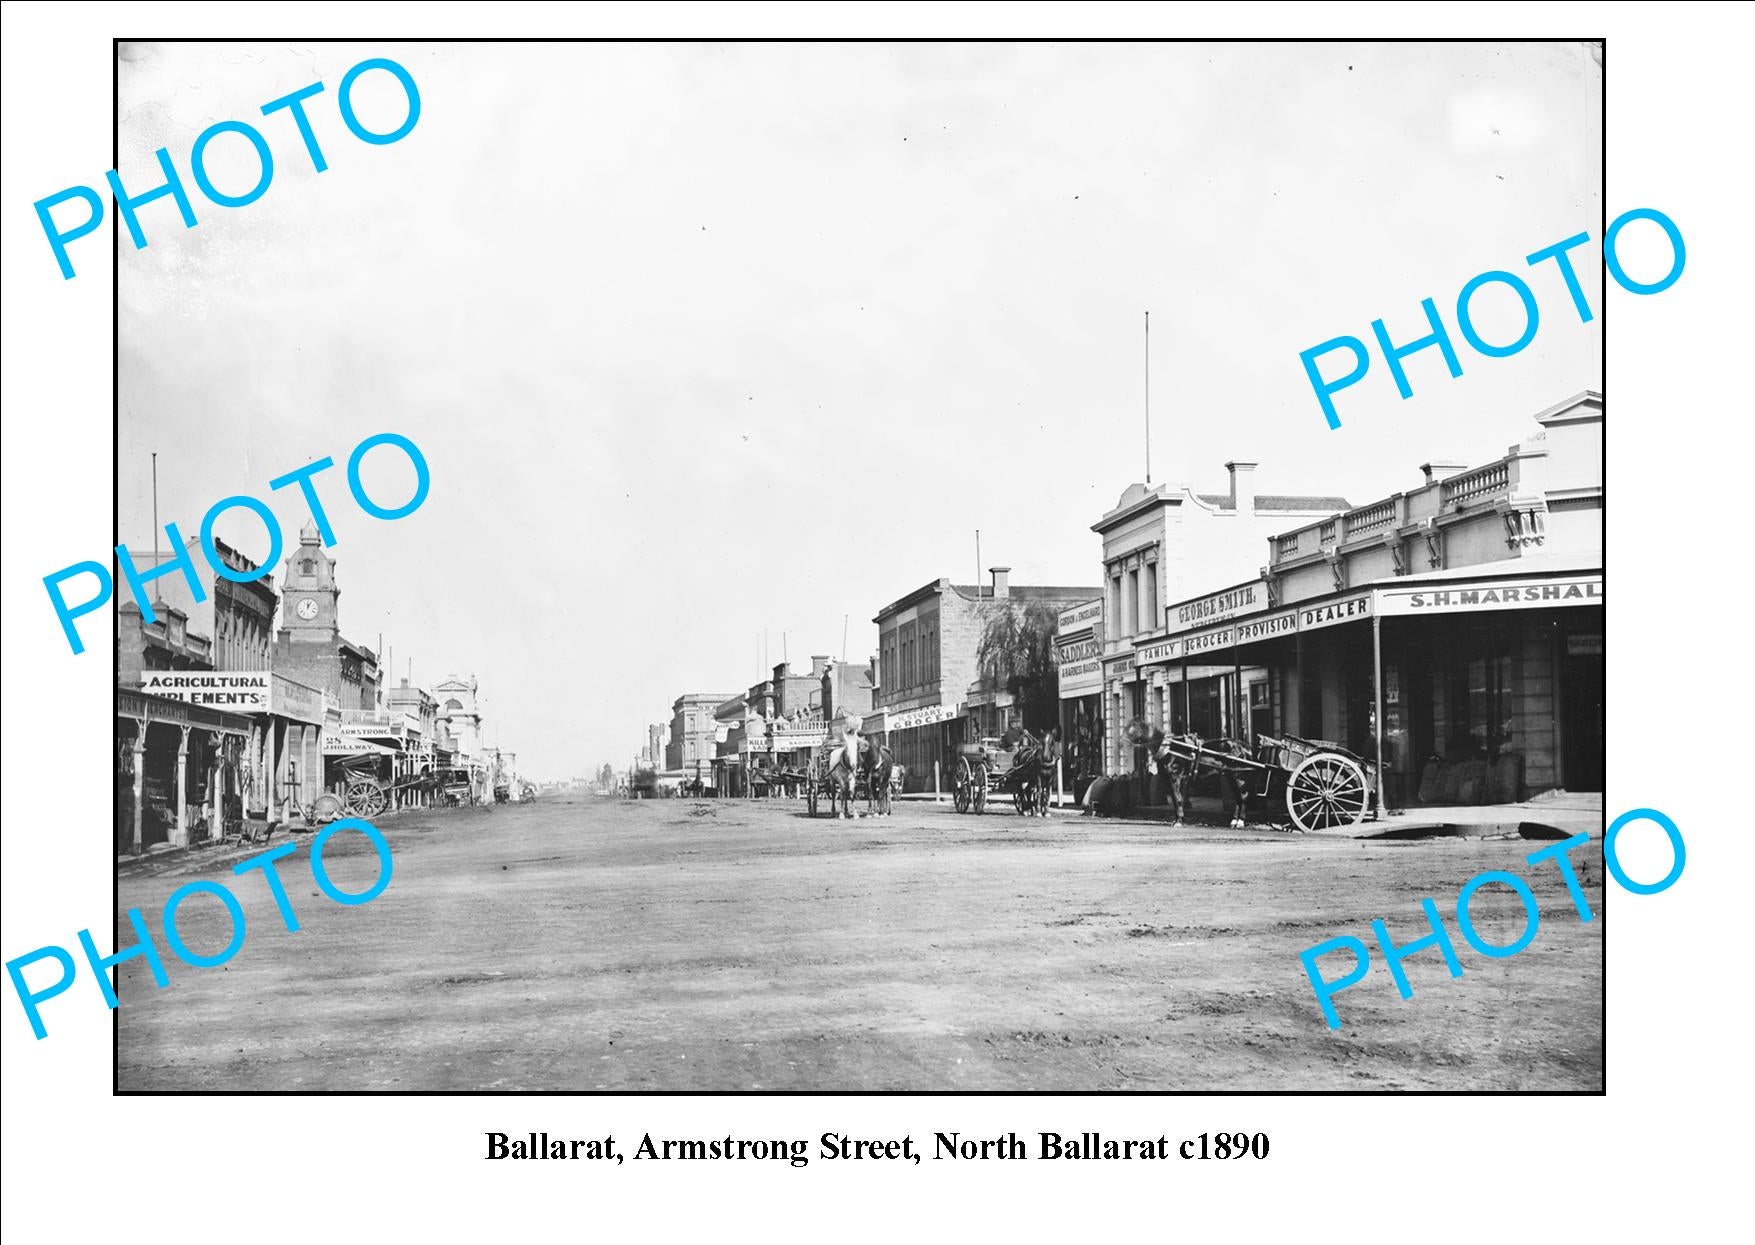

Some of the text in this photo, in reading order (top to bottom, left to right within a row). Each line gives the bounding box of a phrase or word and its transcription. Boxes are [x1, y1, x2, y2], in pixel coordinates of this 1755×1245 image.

[1179, 598, 1217, 623] GEORGE
[1144, 643, 1175, 660] FAMILY
[1189, 632, 1229, 650] GROCER
[1239, 615, 1297, 640] PROVISION
[1306, 599, 1368, 625] DEALER
[150, 676, 268, 688] AGRICULTURAL
[894, 711, 955, 729] GROCER
[341, 728, 390, 736] ARMSTRONG
